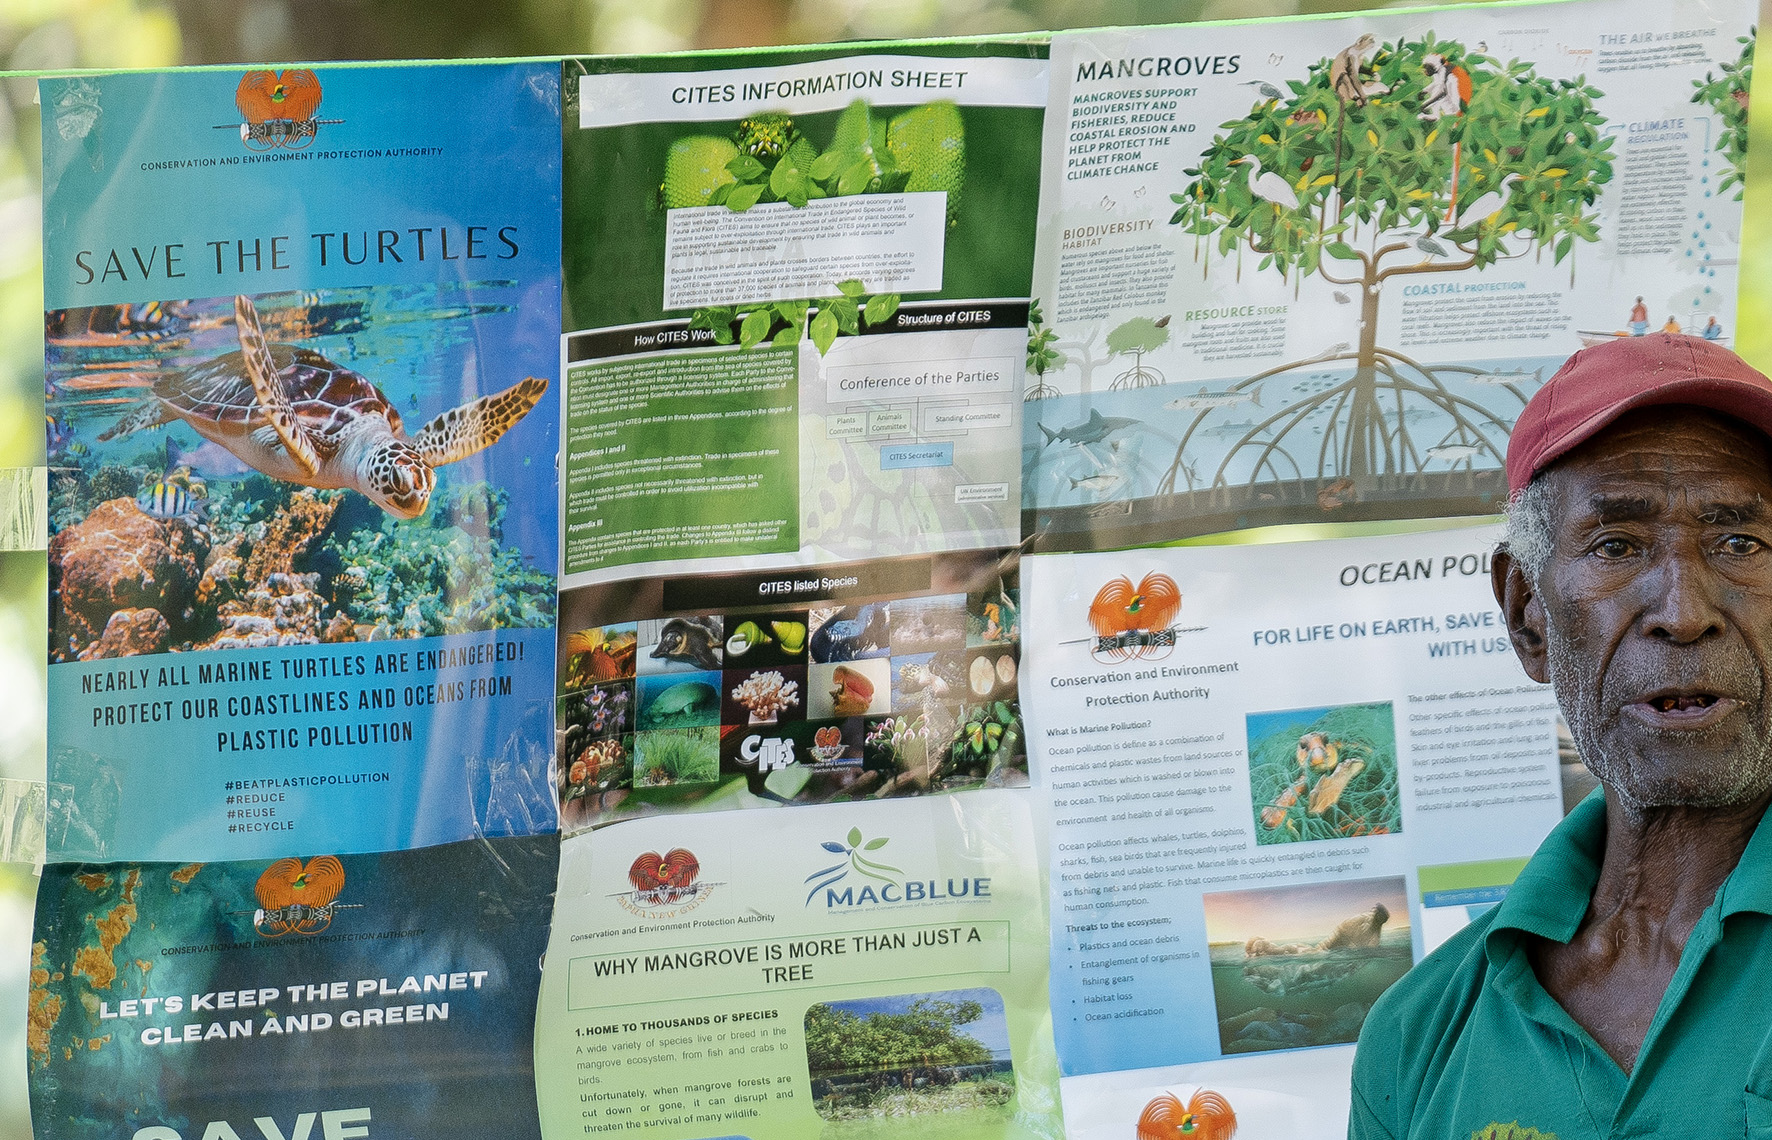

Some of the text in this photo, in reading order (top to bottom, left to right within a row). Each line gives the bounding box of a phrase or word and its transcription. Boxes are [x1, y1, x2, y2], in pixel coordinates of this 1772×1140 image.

[1077, 55, 1240, 82] MANGROVES
[671, 69, 968, 104] CITES INFORMATION SHEET
[1074, 88, 1198, 103] MANGROVES SUPPORT
[1073, 101, 1177, 117] BIODIVERSITY AND
[1071, 113, 1176, 130] FISHERIES, REDUCE
[1070, 124, 1196, 142] COASTAL EROSION AND
[1069, 137, 1171, 155] HELP PROTECT THE
[140, 146, 443, 171] CONSERVATION AND ENVIRONMENT PROTECTION AUTHORITY
[1068, 151, 1141, 167] PLANET FROM
[1067, 163, 1159, 180] CLIMATE CHANGE
[1063, 220, 1154, 240] BIODIVERSITY
[75, 225, 519, 285] SAVE THE TURTLES
[897, 309, 991, 326] Structure of CITES
[634, 328, 717, 346] How CITES Work
[839, 369, 1000, 391] Conference of the Parties
[888, 450, 944, 461] CITES Secretariat
[1340, 558, 1432, 587] OCEAN
[758, 575, 858, 595] CITES listed Species
[1254, 629, 1291, 646] FOR
[1296, 624, 1334, 642] LIFE
[1340, 621, 1367, 638] ON
[1373, 616, 1440, 636] EARTH,
[1445, 612, 1495, 629] SAVE
[82, 641, 525, 694] NEARLY ALL MARINE TURTLES ARE ENDANGERED!
[1050, 661, 1239, 688] Conservation and Environment
[93, 675, 513, 727] PROTECT OUR COASTLINES AND OCEANS FROM
[1085, 686, 1210, 707] Protection Authority
[217, 720, 412, 752] PLASTIC POLLUTION
[224, 771, 389, 791] #BEATPLASTICPOLLUTION
[225, 792, 285, 805] #REDUCE
[226, 807, 276, 819] #REUSE
[227, 820, 294, 834] #RECYCLE
[827, 879, 991, 908] MACBLUE
[593, 926, 982, 977] WHY MANGROVE IS MORE THAN JUST A
[761, 963, 814, 984] TREE
[99, 970, 489, 1019] LET'S KEEP THE PLANET
[140, 1002, 449, 1046] CLEAN AND GREEN
[621, 1022, 637, 1032] TO
[639, 1015, 710, 1031] THOUSANDS
[713, 1013, 728, 1024] OF
[731, 1009, 779, 1022] SPECIES
